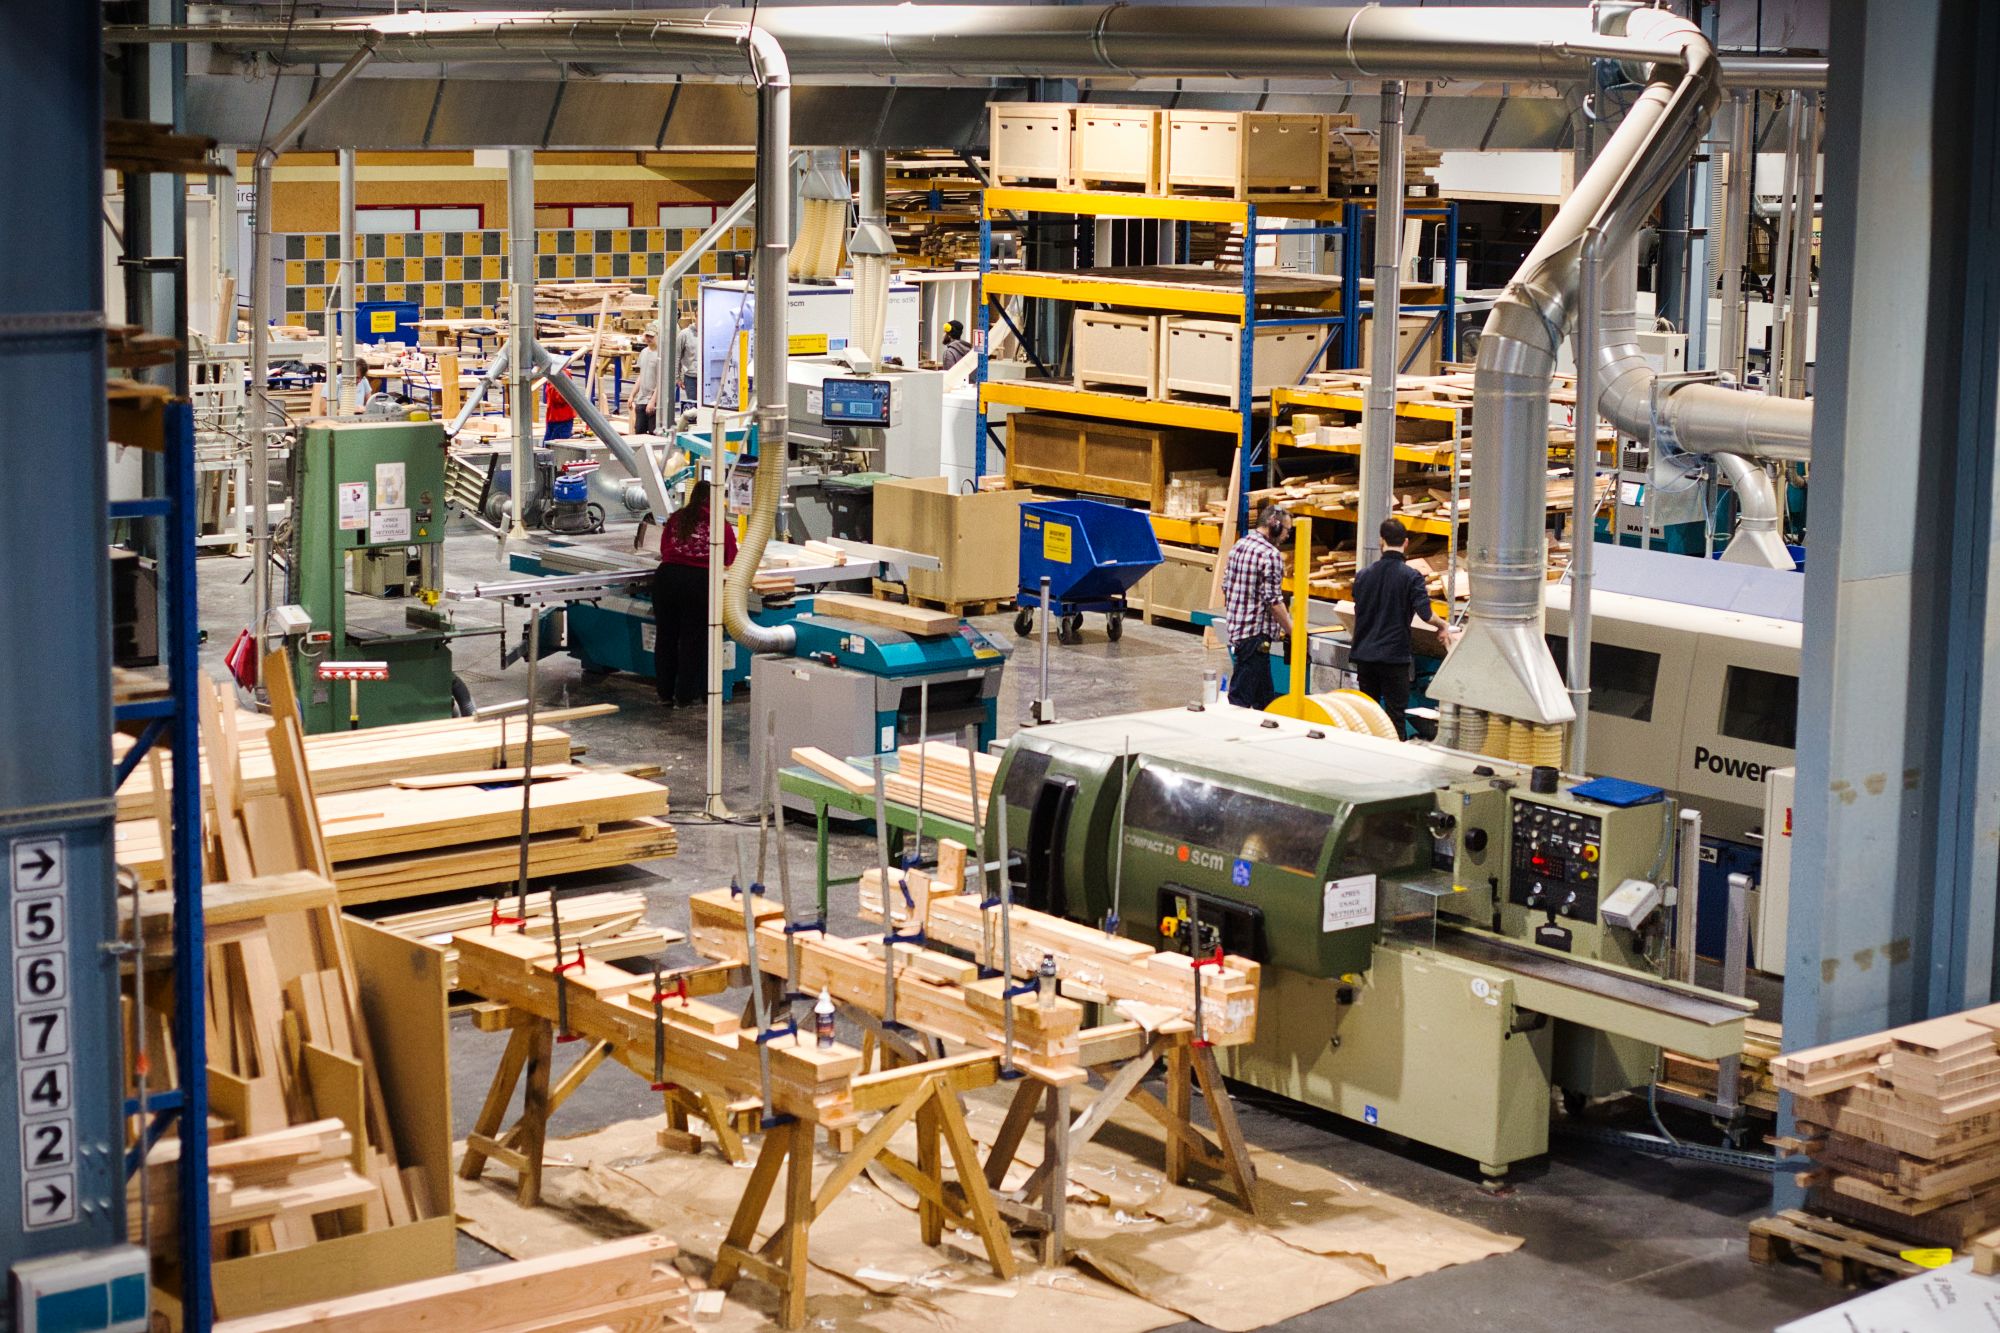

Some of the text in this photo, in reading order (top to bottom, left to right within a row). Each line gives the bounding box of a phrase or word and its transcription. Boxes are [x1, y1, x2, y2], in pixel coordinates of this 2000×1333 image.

[1627, 525, 1660, 535] MAIN
[1694, 746, 1776, 783] Power
[1190, 850, 1224, 872] scm
[27, 902, 55, 941] 5
[27, 958, 57, 995] 6
[29, 1013, 59, 1054] 7
[32, 1069, 62, 1107] 4
[34, 1125, 64, 1165] 2
